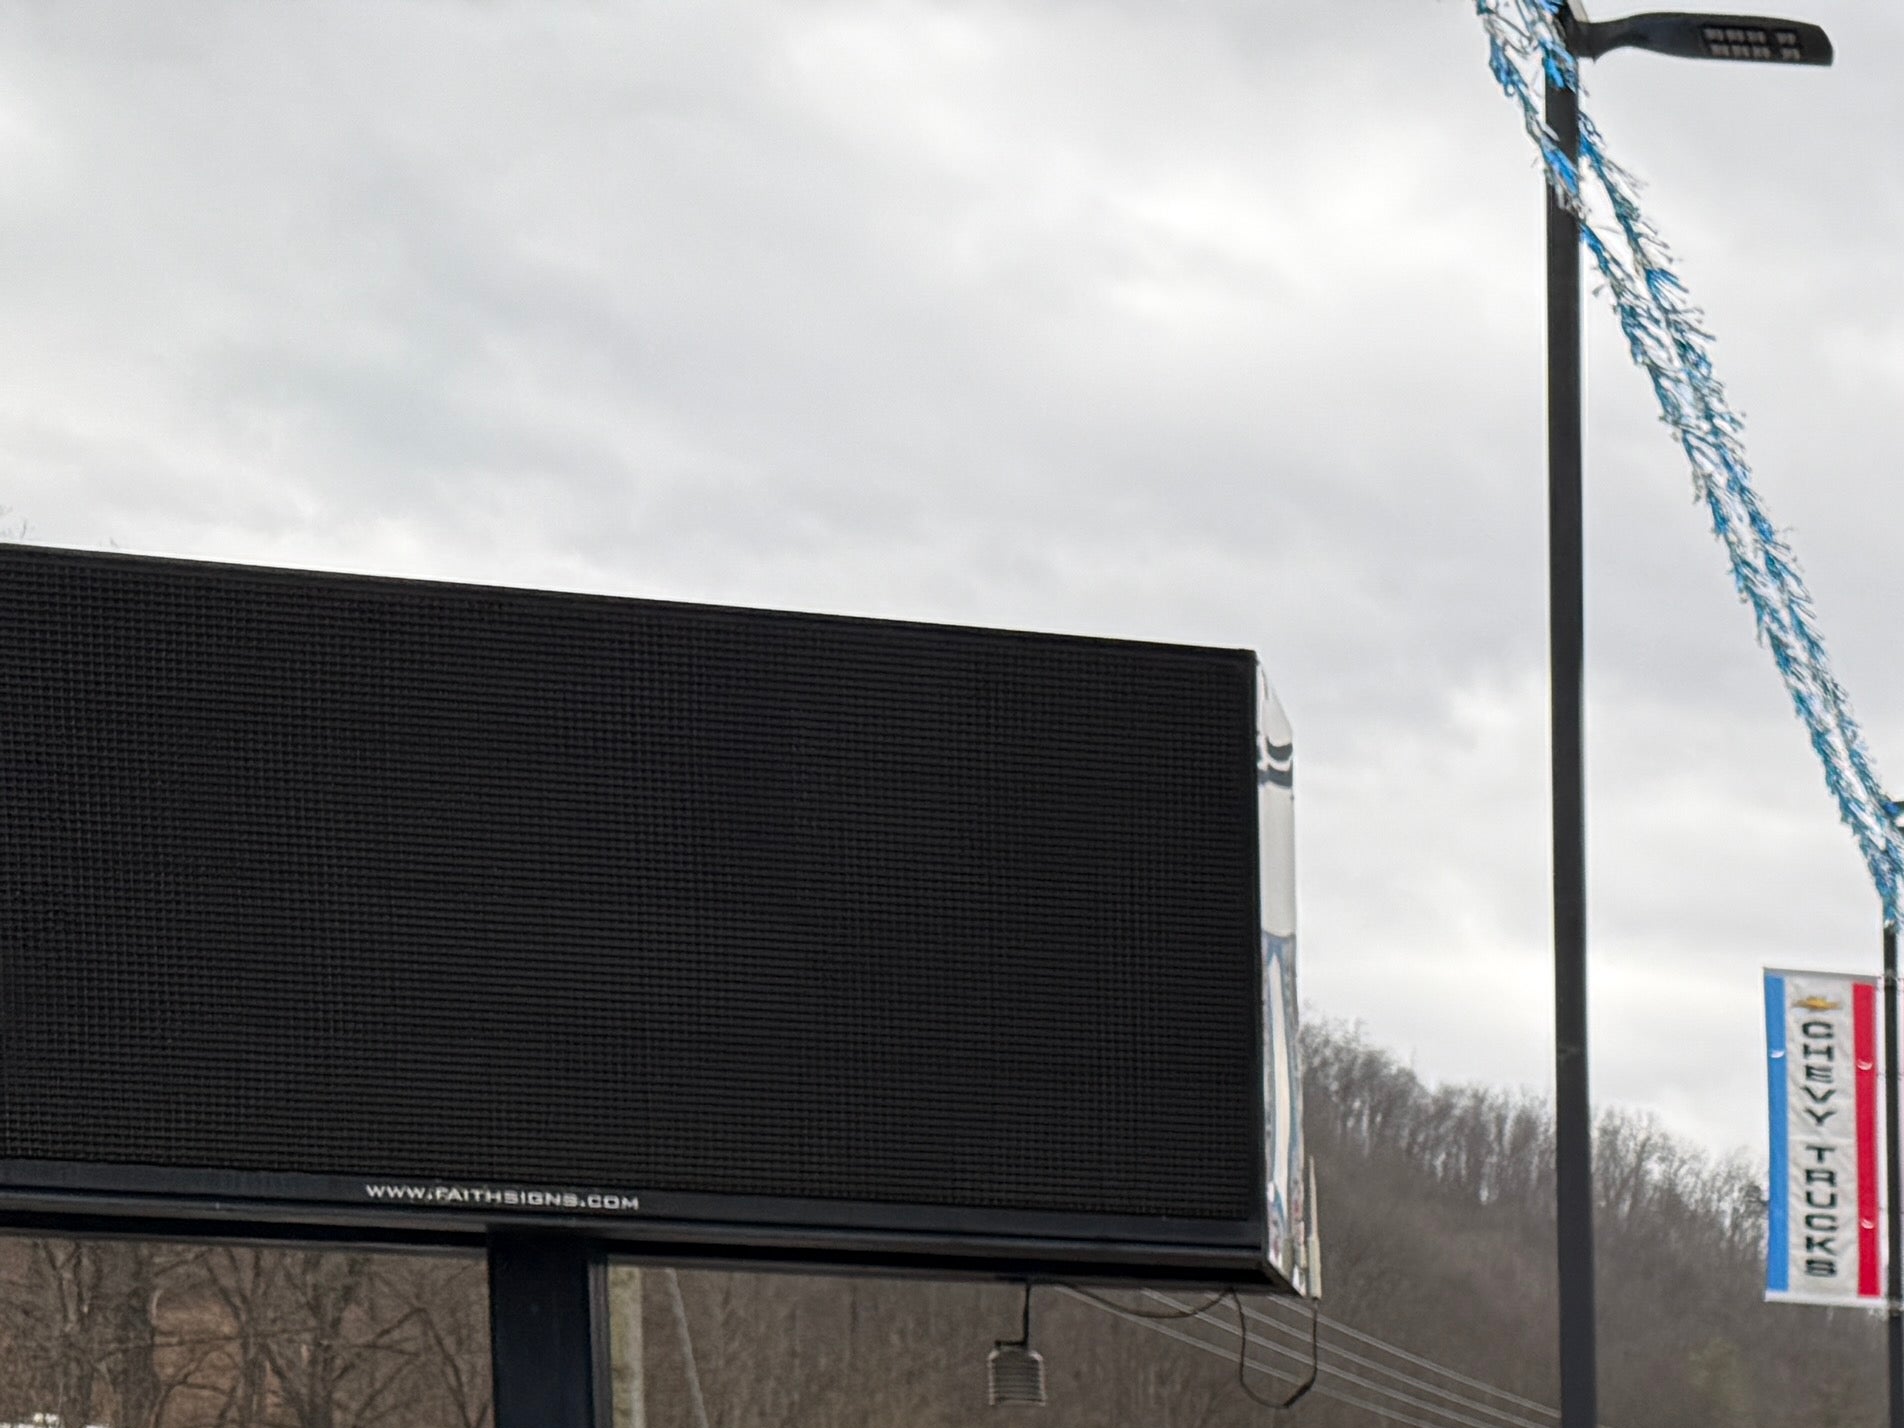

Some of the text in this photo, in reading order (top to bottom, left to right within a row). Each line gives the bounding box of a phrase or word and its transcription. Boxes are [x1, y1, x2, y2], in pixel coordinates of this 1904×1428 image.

[364, 1183, 640, 1211] WWW.FAITHSIGNS.COM
[1801, 1020, 1837, 1278] CHEVY TRUCKS
